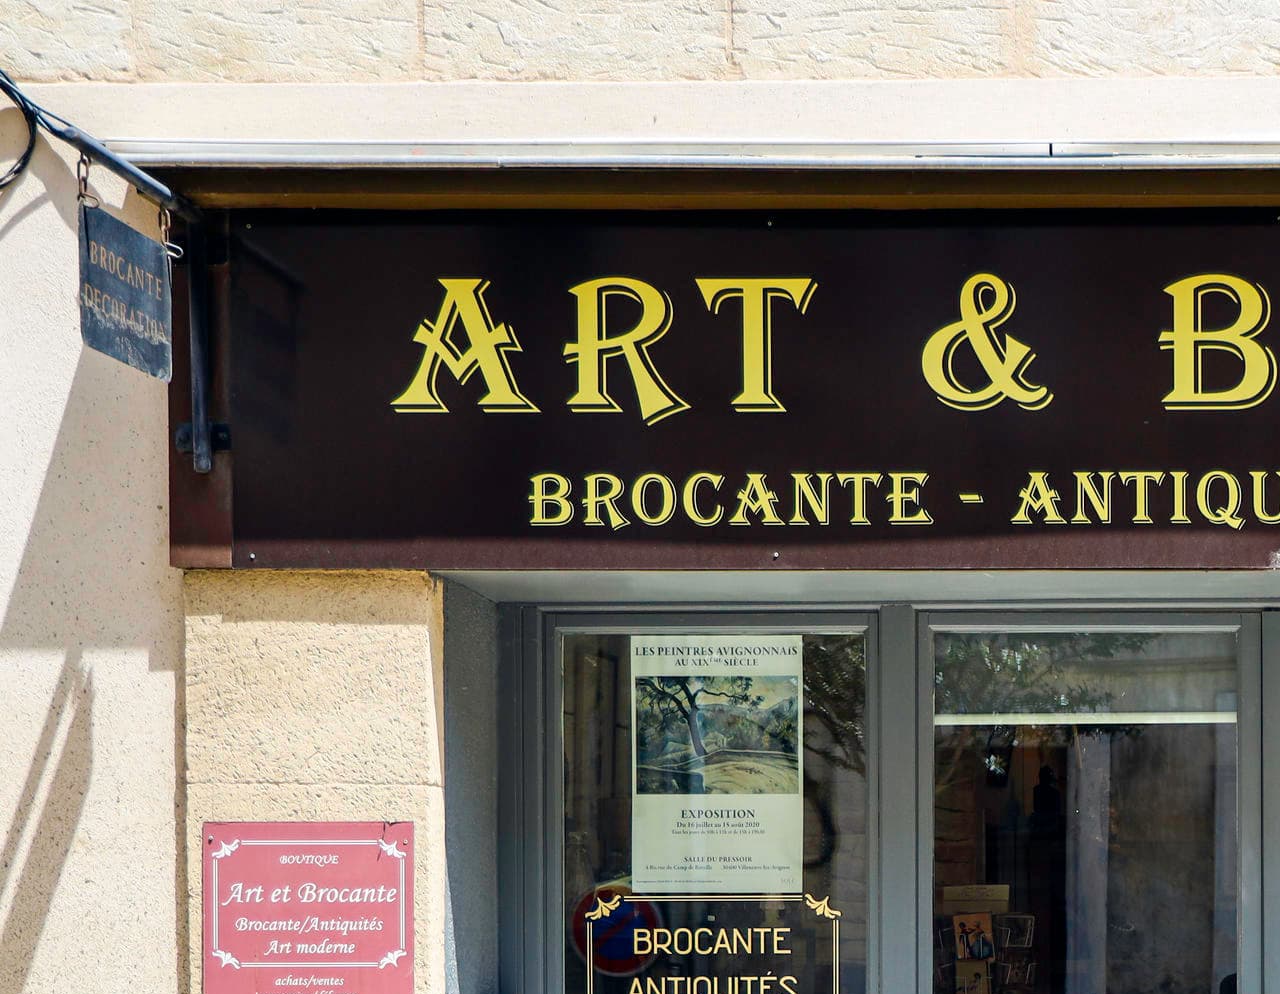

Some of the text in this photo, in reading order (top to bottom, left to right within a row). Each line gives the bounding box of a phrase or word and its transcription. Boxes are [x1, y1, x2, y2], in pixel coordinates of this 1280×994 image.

[90, 240, 162, 301] BROCANTE
[390, 276, 819, 427] ART
[922, 273, 1054, 412] &
[528, 472, 935, 531] BROCANTE
[635, 646, 798, 656] LES PEINTRES AVIGNONNAIS
[674, 658, 688, 666] AU
[681, 809, 755, 819] EXPOSITION
[279, 855, 340, 867] BOUTIQUE
[222, 882, 397, 906] Art et Brocante
[234, 915, 384, 936] Brocante/Antiquités
[264, 938, 356, 956] Art moderne
[633, 928, 792, 955] BROCANTE
[275, 974, 345, 988] achats/ventes
